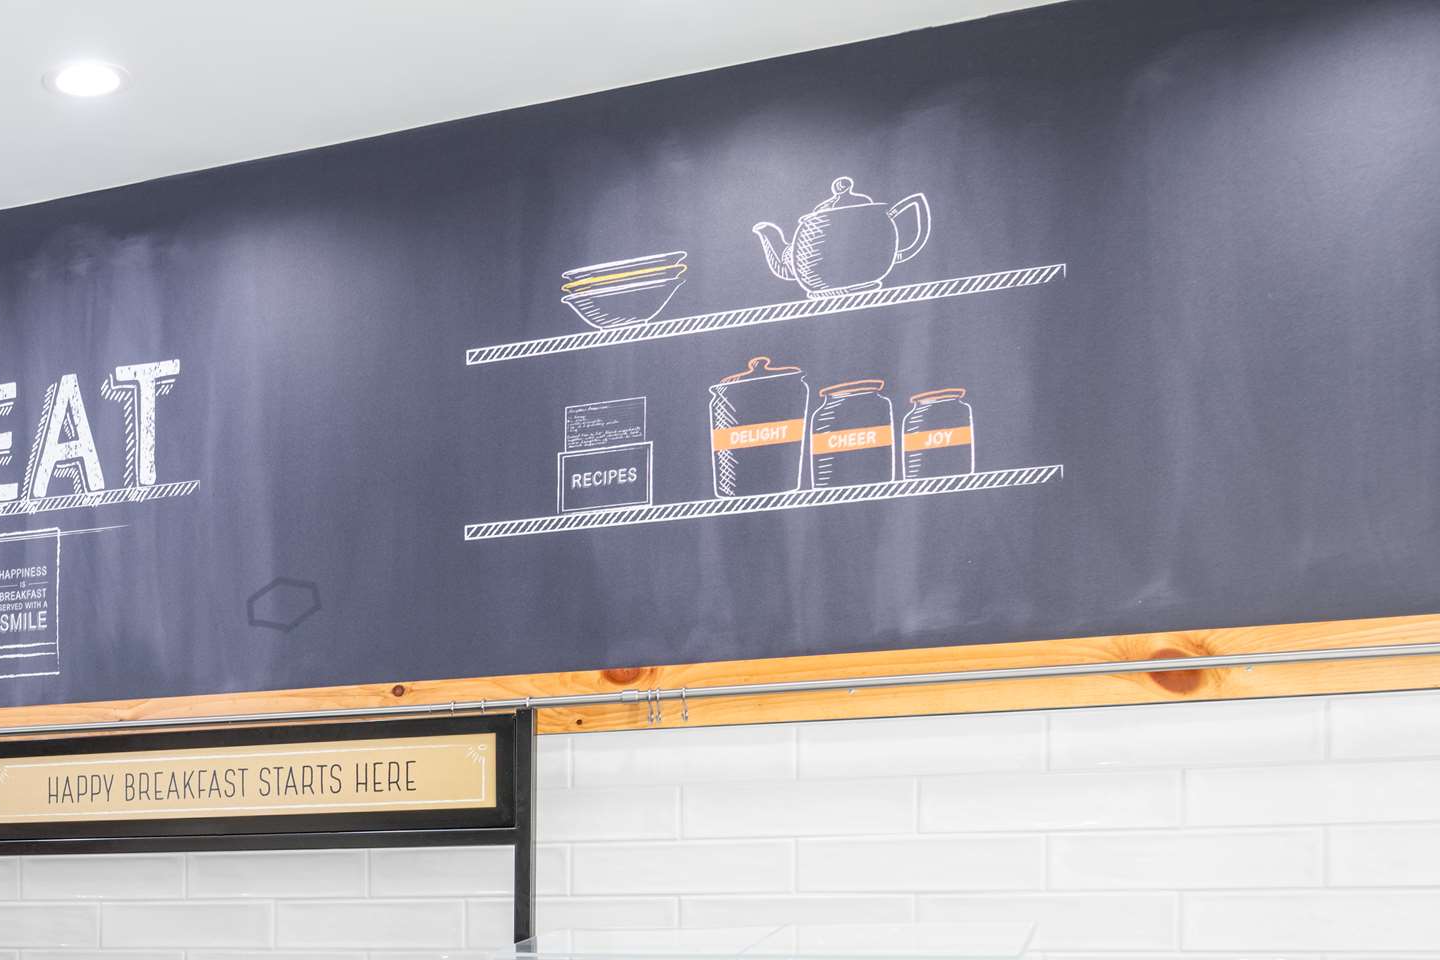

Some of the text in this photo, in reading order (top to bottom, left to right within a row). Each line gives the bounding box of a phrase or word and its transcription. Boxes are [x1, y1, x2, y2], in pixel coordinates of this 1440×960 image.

[730, 425, 788, 445] DELIGHT
[828, 431, 876, 448] CHEER
[924, 431, 953, 447] JOY
[571, 467, 638, 489] RECIPES
[0, 588, 47, 602] BREAKFAST
[25, 600, 42, 609] WITH
[0, 611, 48, 632] SMILE
[48, 760, 417, 804] HAPPY BREAKFAST STARTS HERE
